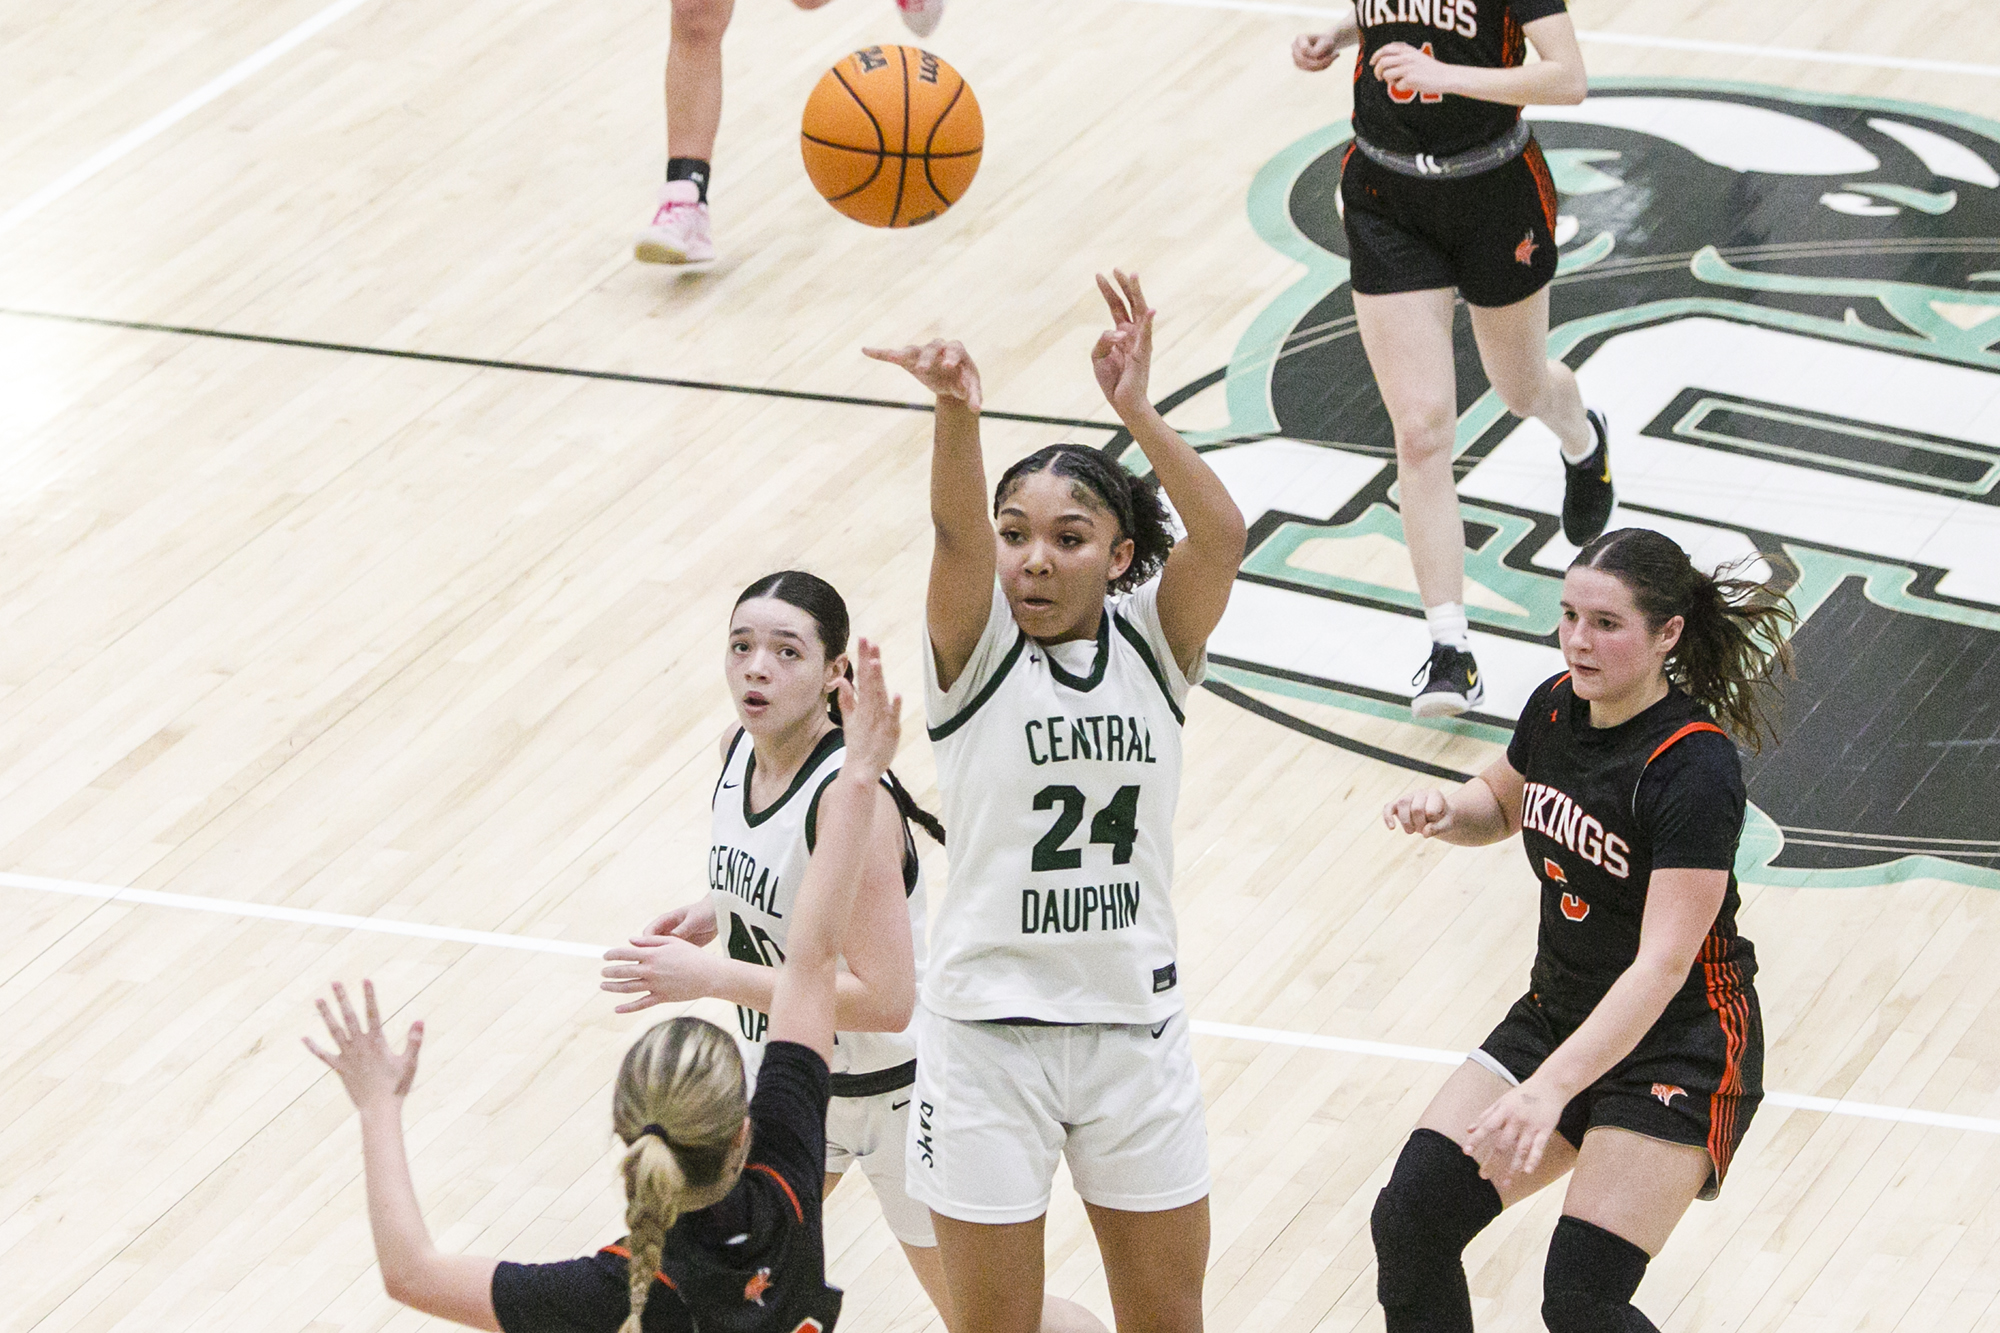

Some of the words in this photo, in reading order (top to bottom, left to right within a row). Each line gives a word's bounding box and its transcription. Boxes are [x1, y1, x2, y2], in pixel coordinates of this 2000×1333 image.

[1025, 714, 1157, 766] CENTRAL
[1031, 785, 1141, 872] 24
[1521, 782, 1631, 879] IKINGS
[708, 845, 783, 919] CENTRAL
[1021, 880, 1140, 934] DAUPHIN
